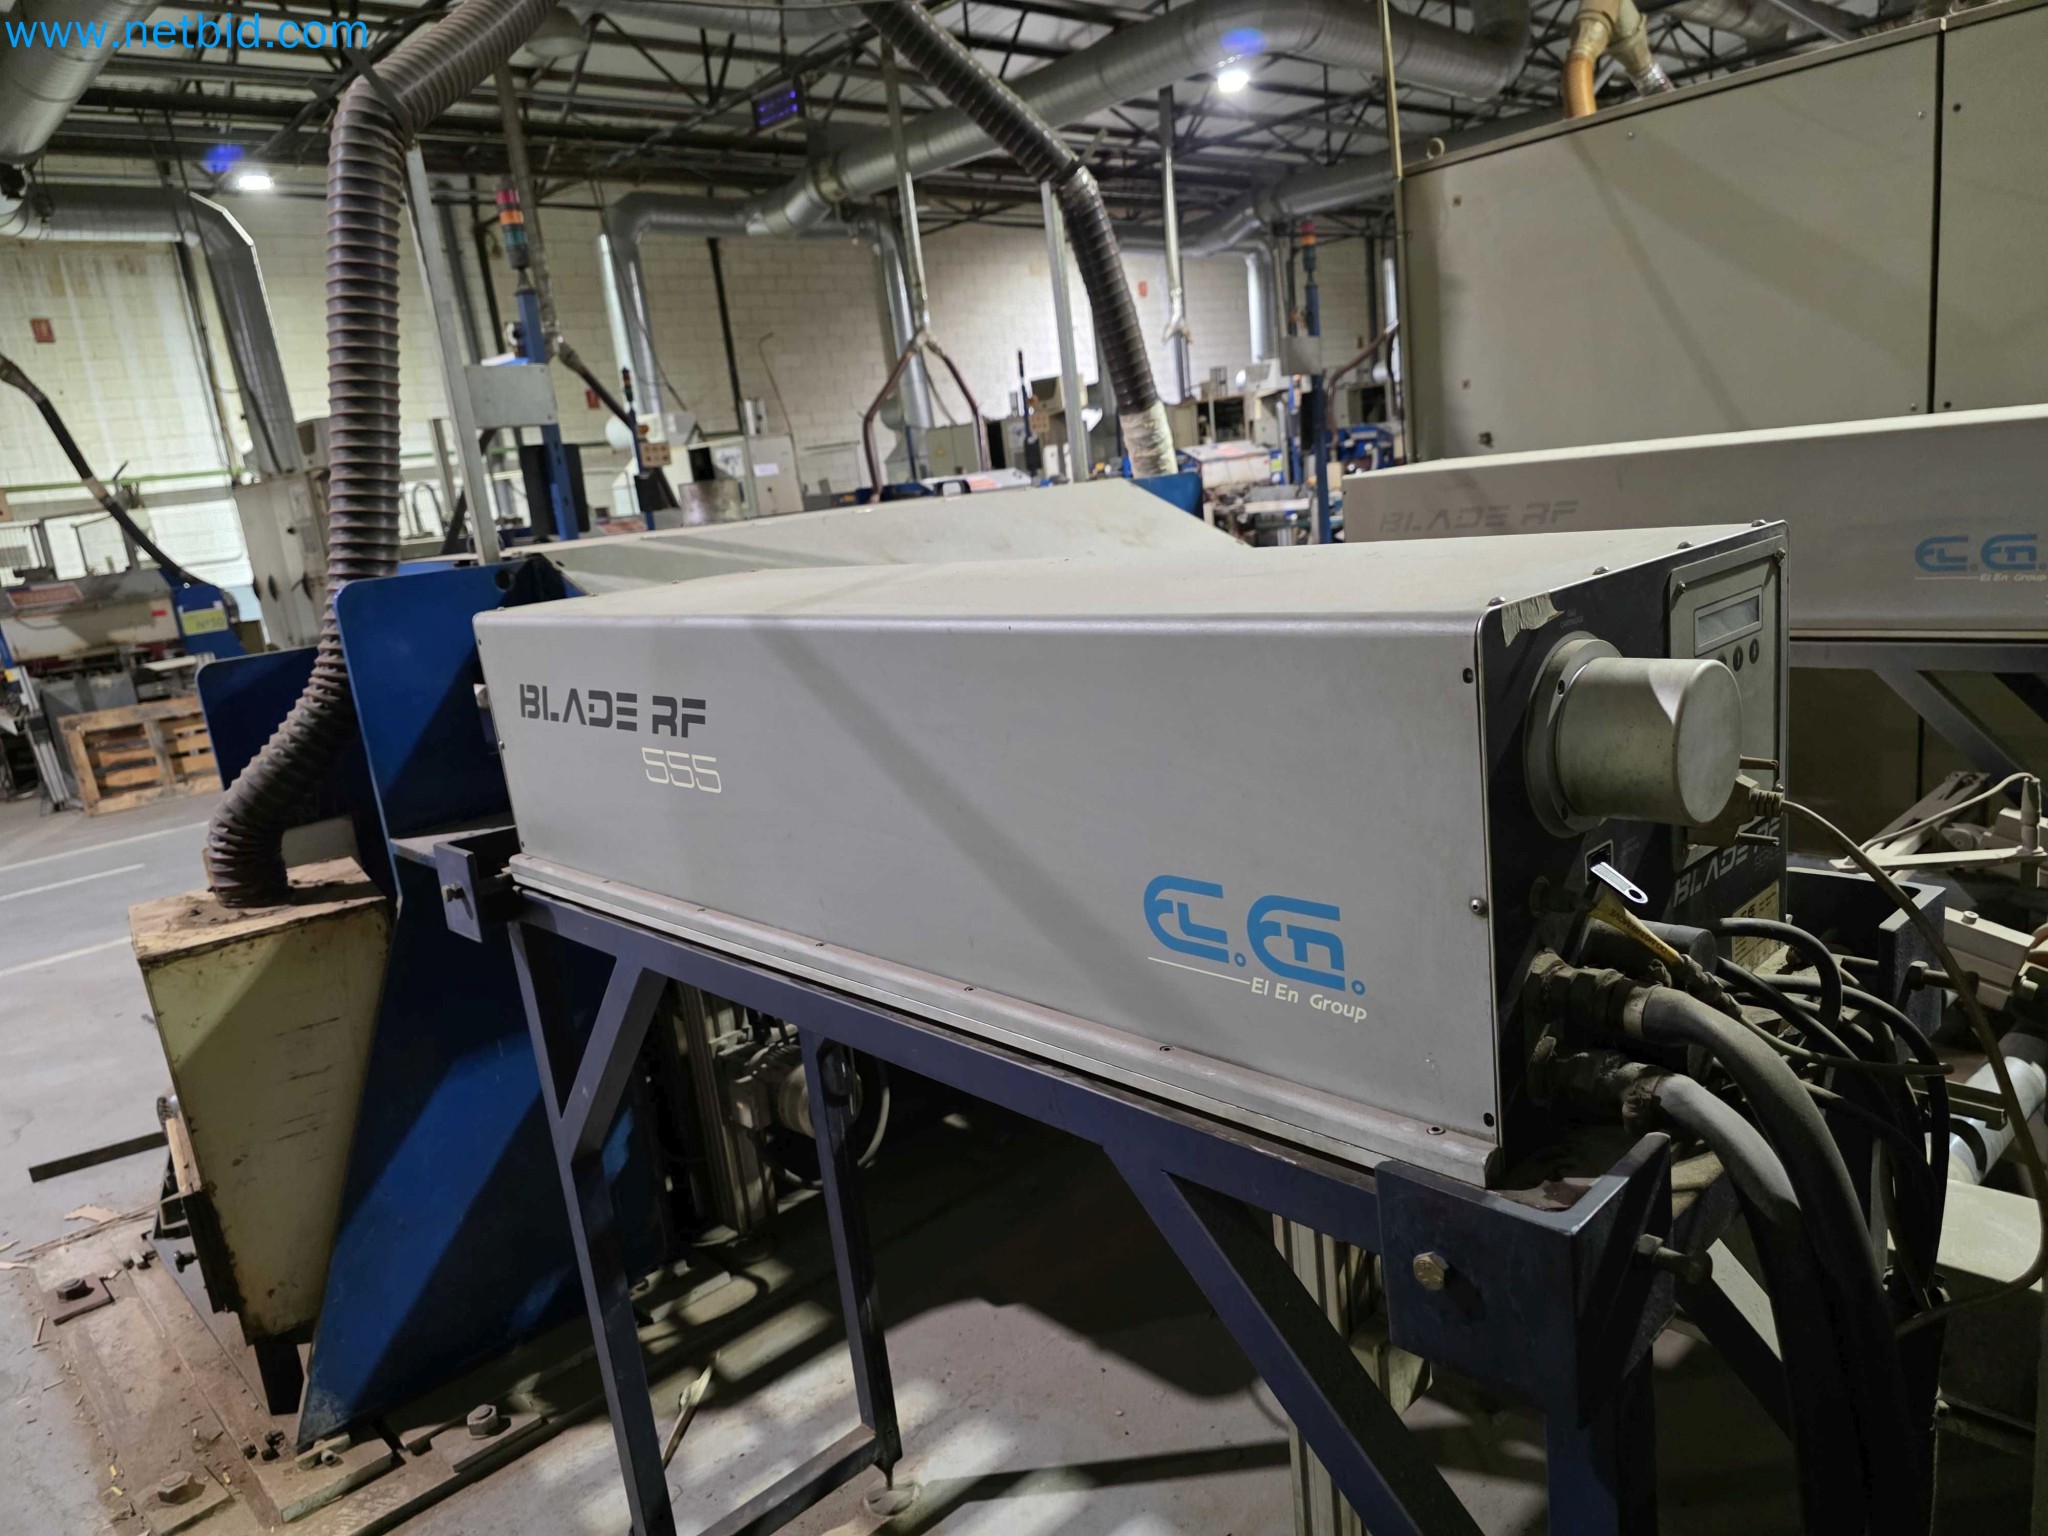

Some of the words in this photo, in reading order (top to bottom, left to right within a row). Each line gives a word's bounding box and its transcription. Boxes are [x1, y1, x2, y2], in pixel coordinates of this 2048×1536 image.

[1380, 504, 1512, 533] BLADE
[1520, 500, 1580, 526] RF
[519, 683, 638, 732] BLADE
[652, 695, 707, 738] RF
[1673, 844, 1749, 908] BLADE
[1251, 977, 1270, 996] El
[1274, 982, 1300, 1004] En
[1309, 994, 1368, 1024] Group
